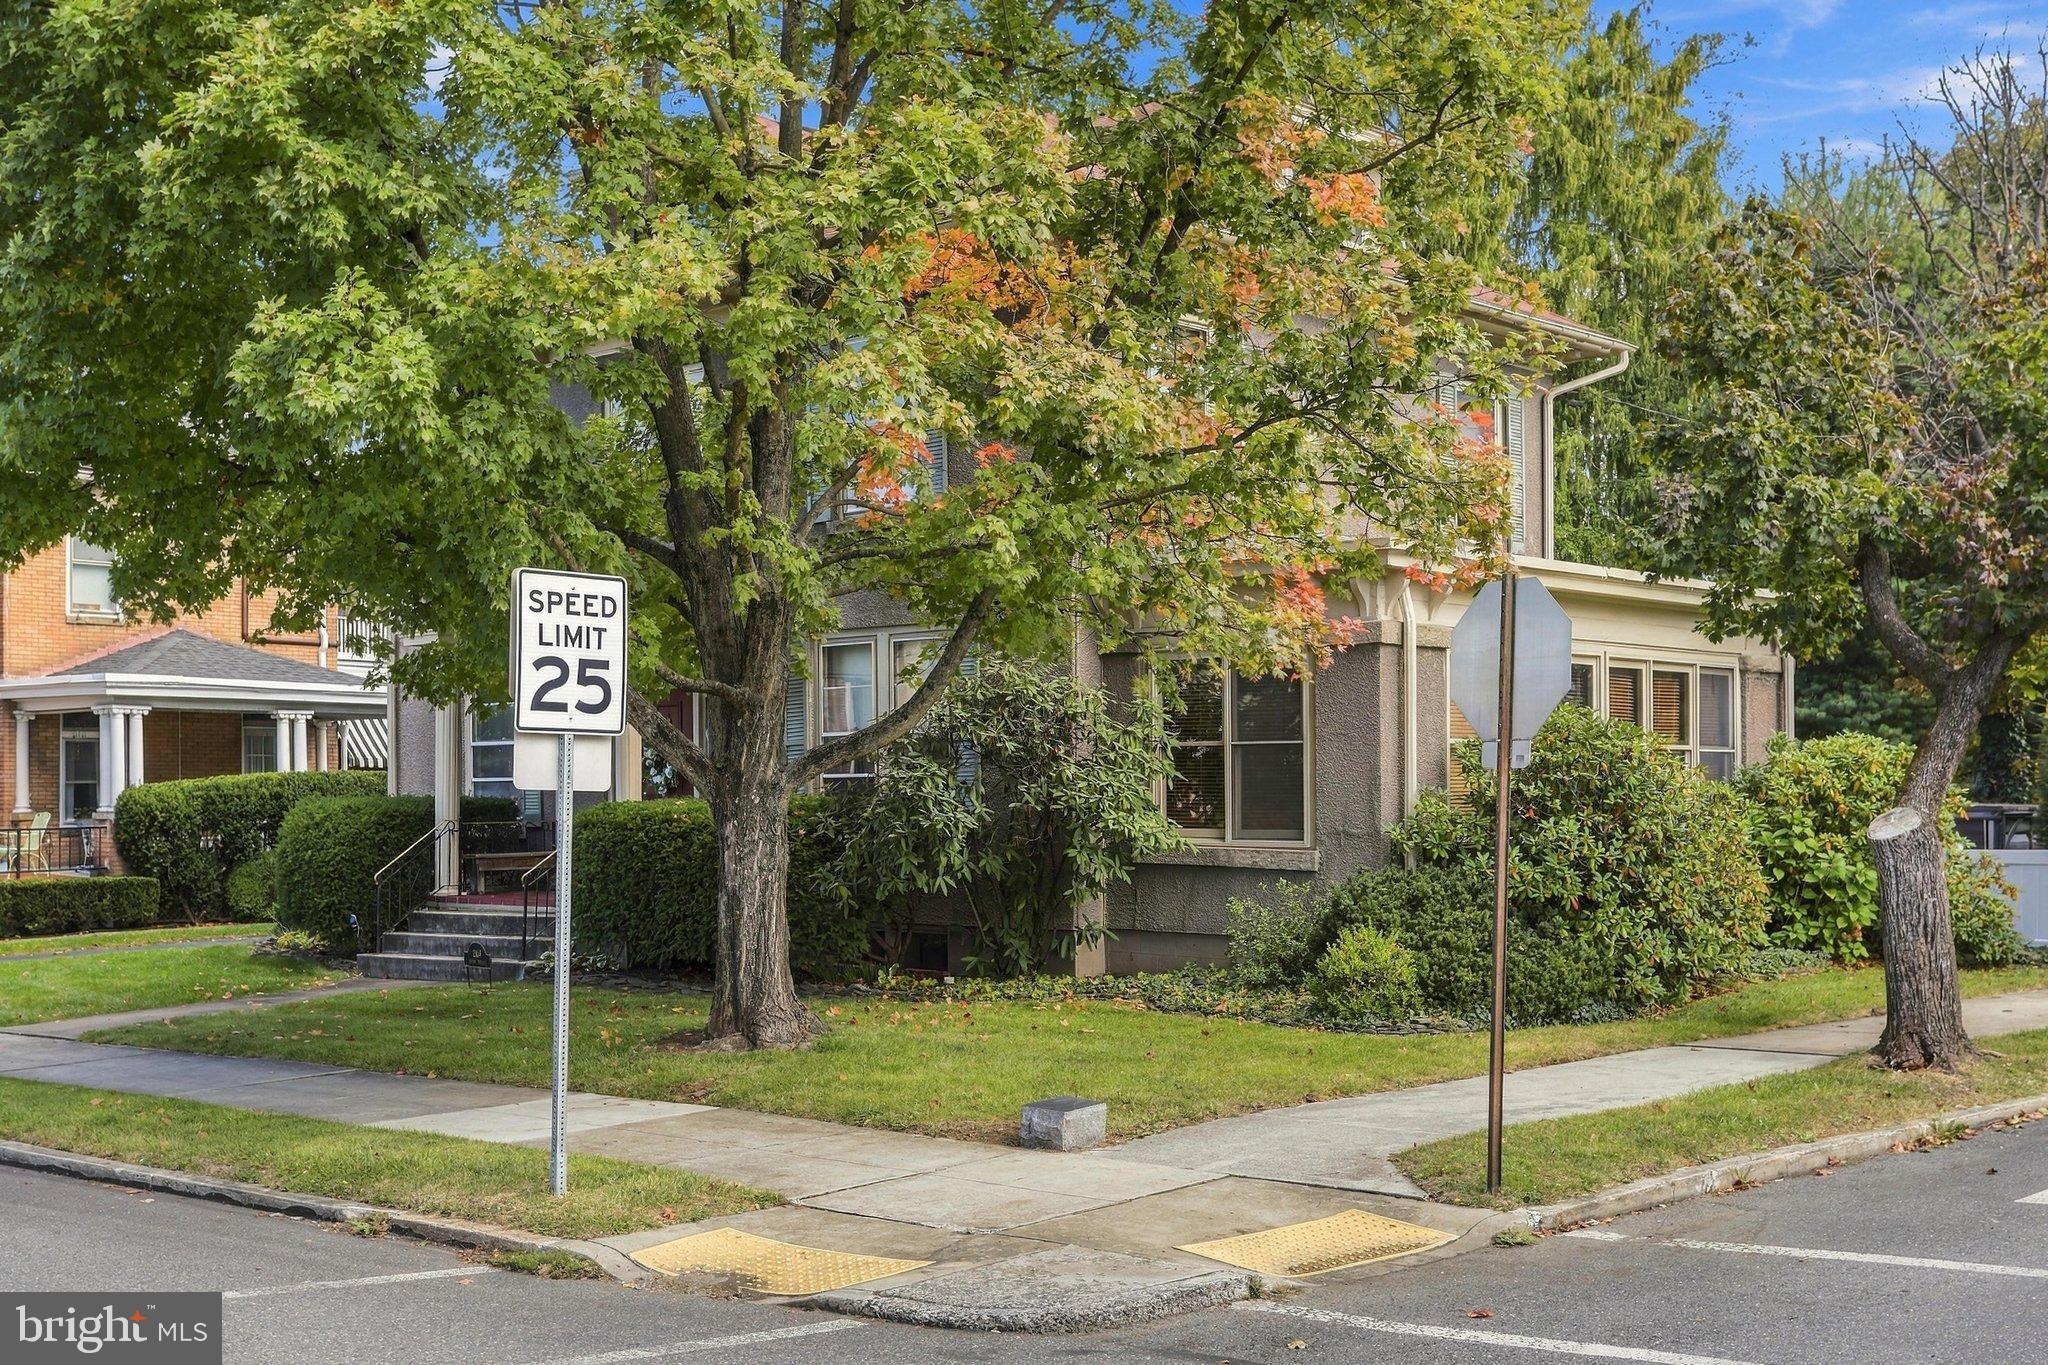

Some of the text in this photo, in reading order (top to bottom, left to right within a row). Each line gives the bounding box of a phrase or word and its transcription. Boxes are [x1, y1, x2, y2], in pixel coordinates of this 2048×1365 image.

[528, 588, 618, 619] SPEED
[538, 622, 607, 651] LIMIT
[530, 655, 613, 715] 25
